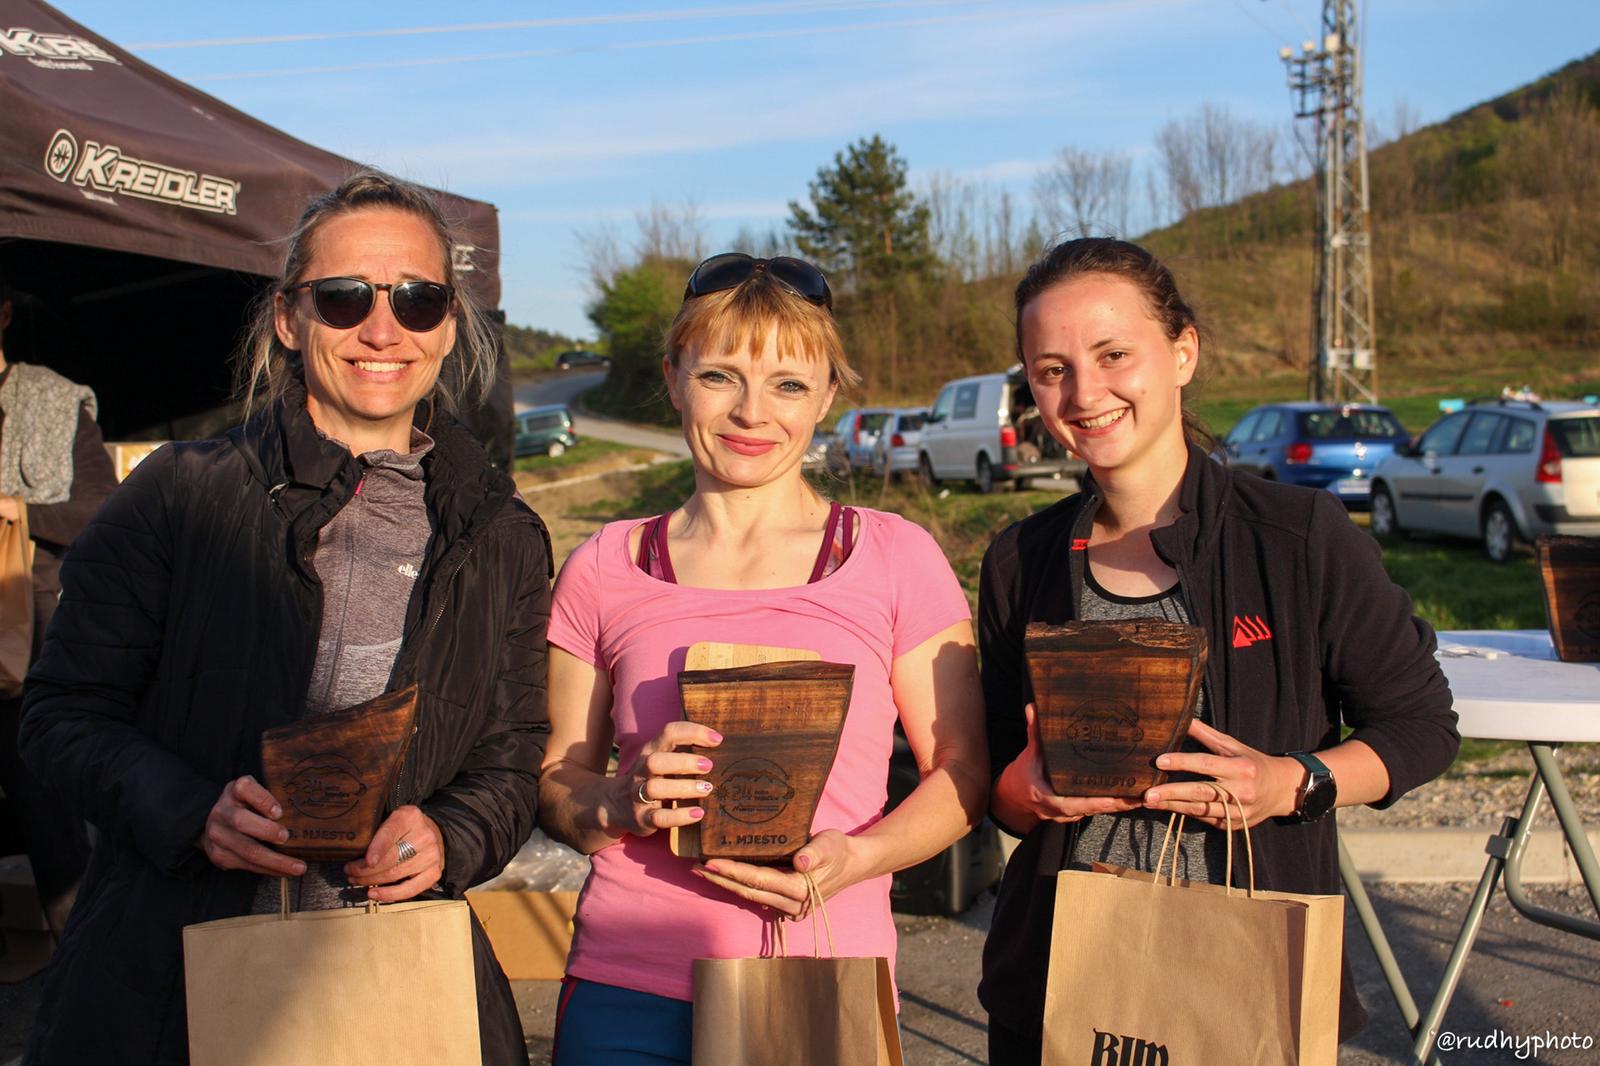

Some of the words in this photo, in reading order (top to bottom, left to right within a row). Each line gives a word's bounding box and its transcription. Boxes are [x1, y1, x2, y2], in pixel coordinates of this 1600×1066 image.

[73, 140, 237, 215] KREIDLER
[303, 829, 357, 841] MJESTO
[720, 834, 732, 846] 1.
[735, 833, 788, 846] MJESTO
